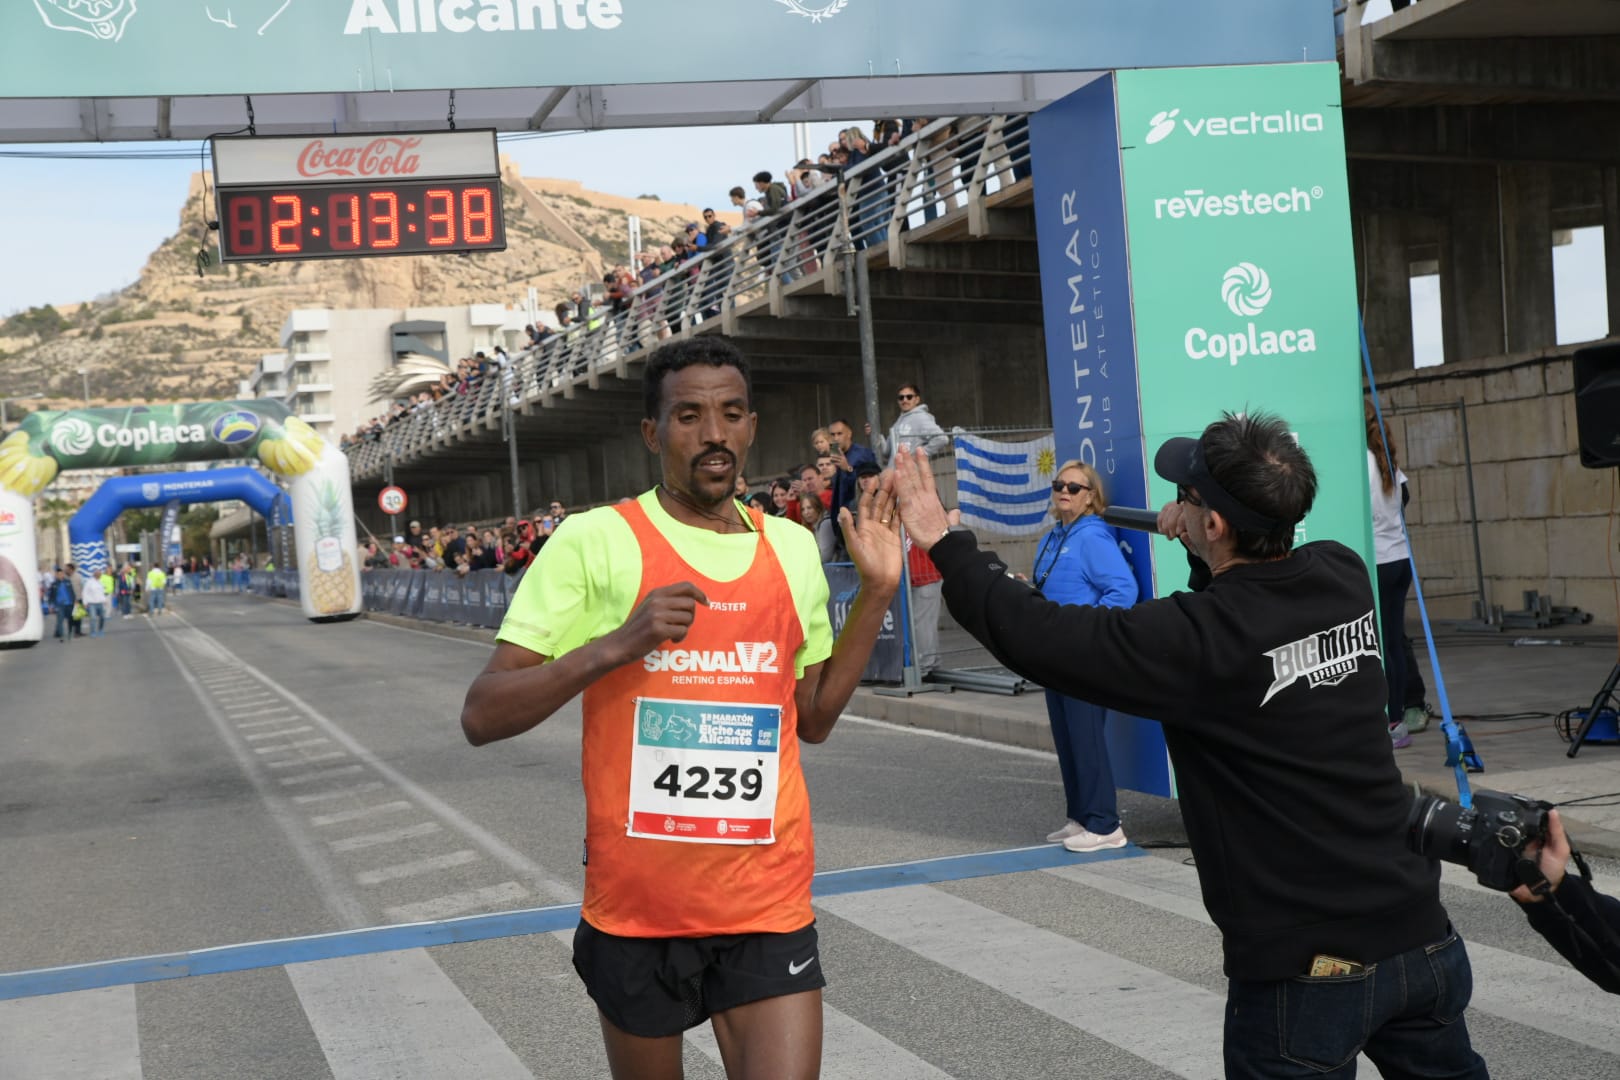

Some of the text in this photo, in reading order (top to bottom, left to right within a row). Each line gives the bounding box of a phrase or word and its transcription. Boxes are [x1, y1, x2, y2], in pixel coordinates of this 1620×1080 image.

[1182, 110, 1323, 136] vectalia
[297, 137, 422, 178] Coca-Cola
[271, 188, 492, 251] 2:13:38
[1061, 190, 1096, 470] ONTEMAR
[1184, 322, 1316, 366] Coplaca
[1089, 229, 1115, 475] CLUB ATLÉTICO
[96, 420, 206, 451] Coplaca
[709, 602, 747, 611] FASTER
[672, 675, 755, 685] RENTING ESPAÑA
[1312, 660, 1353, 682] SPEAKER
[698, 733, 753, 746] Alicante
[653, 764, 763, 802] 4239
